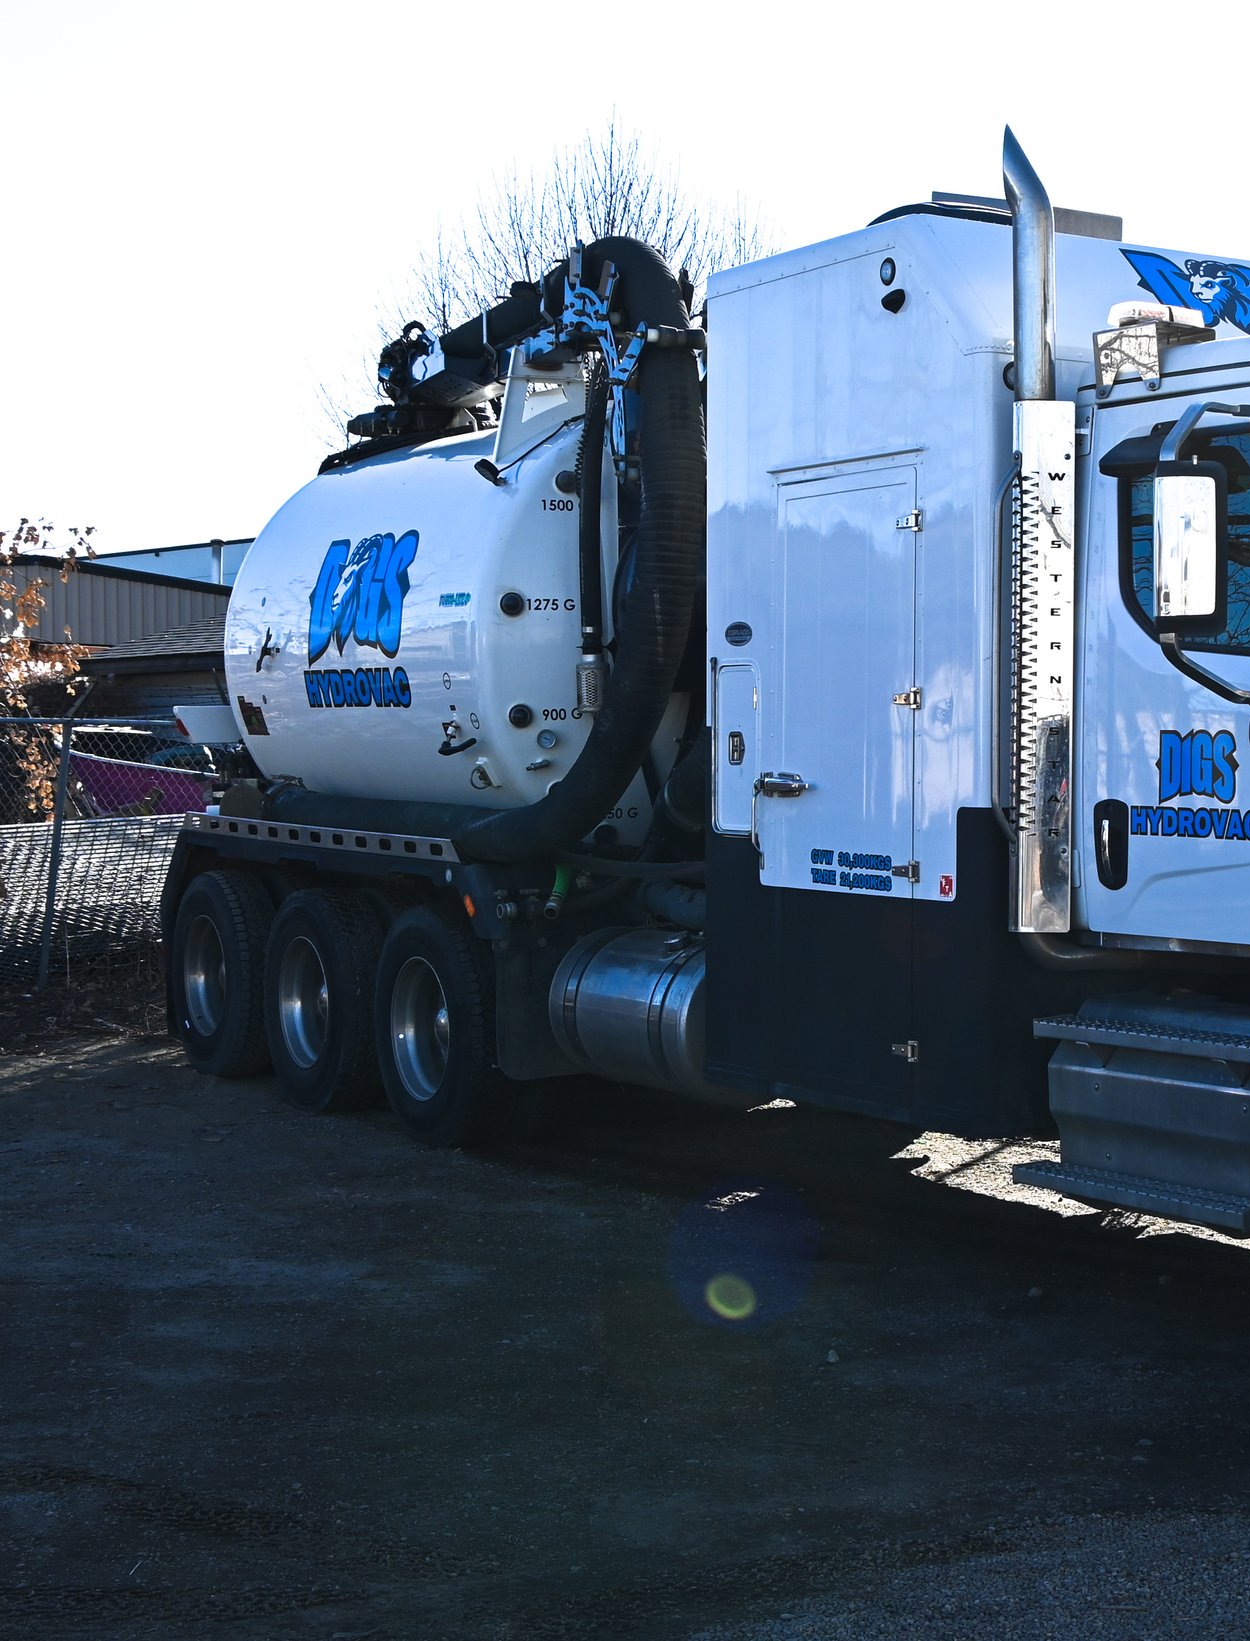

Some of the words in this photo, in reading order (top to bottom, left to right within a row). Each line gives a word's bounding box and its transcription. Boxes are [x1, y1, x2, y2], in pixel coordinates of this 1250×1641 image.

[541, 499, 574, 512] 1500
[1047, 472, 1066, 685] WESTERN
[309, 529, 420, 669] DGS
[526, 598, 559, 611] 1275
[563, 598, 576, 611] G
[304, 666, 412, 709] HYDROVAC
[542, 708, 567, 721] 900
[1047, 716, 1061, 838] STAR
[1155, 729, 1240, 805] DIGS
[605, 807, 624, 819] 50
[811, 848, 835, 865] GVW
[838, 851, 892, 872] 30,300KGS
[811, 868, 837, 885] TARE
[840, 871, 892, 892] 21,200KGS
